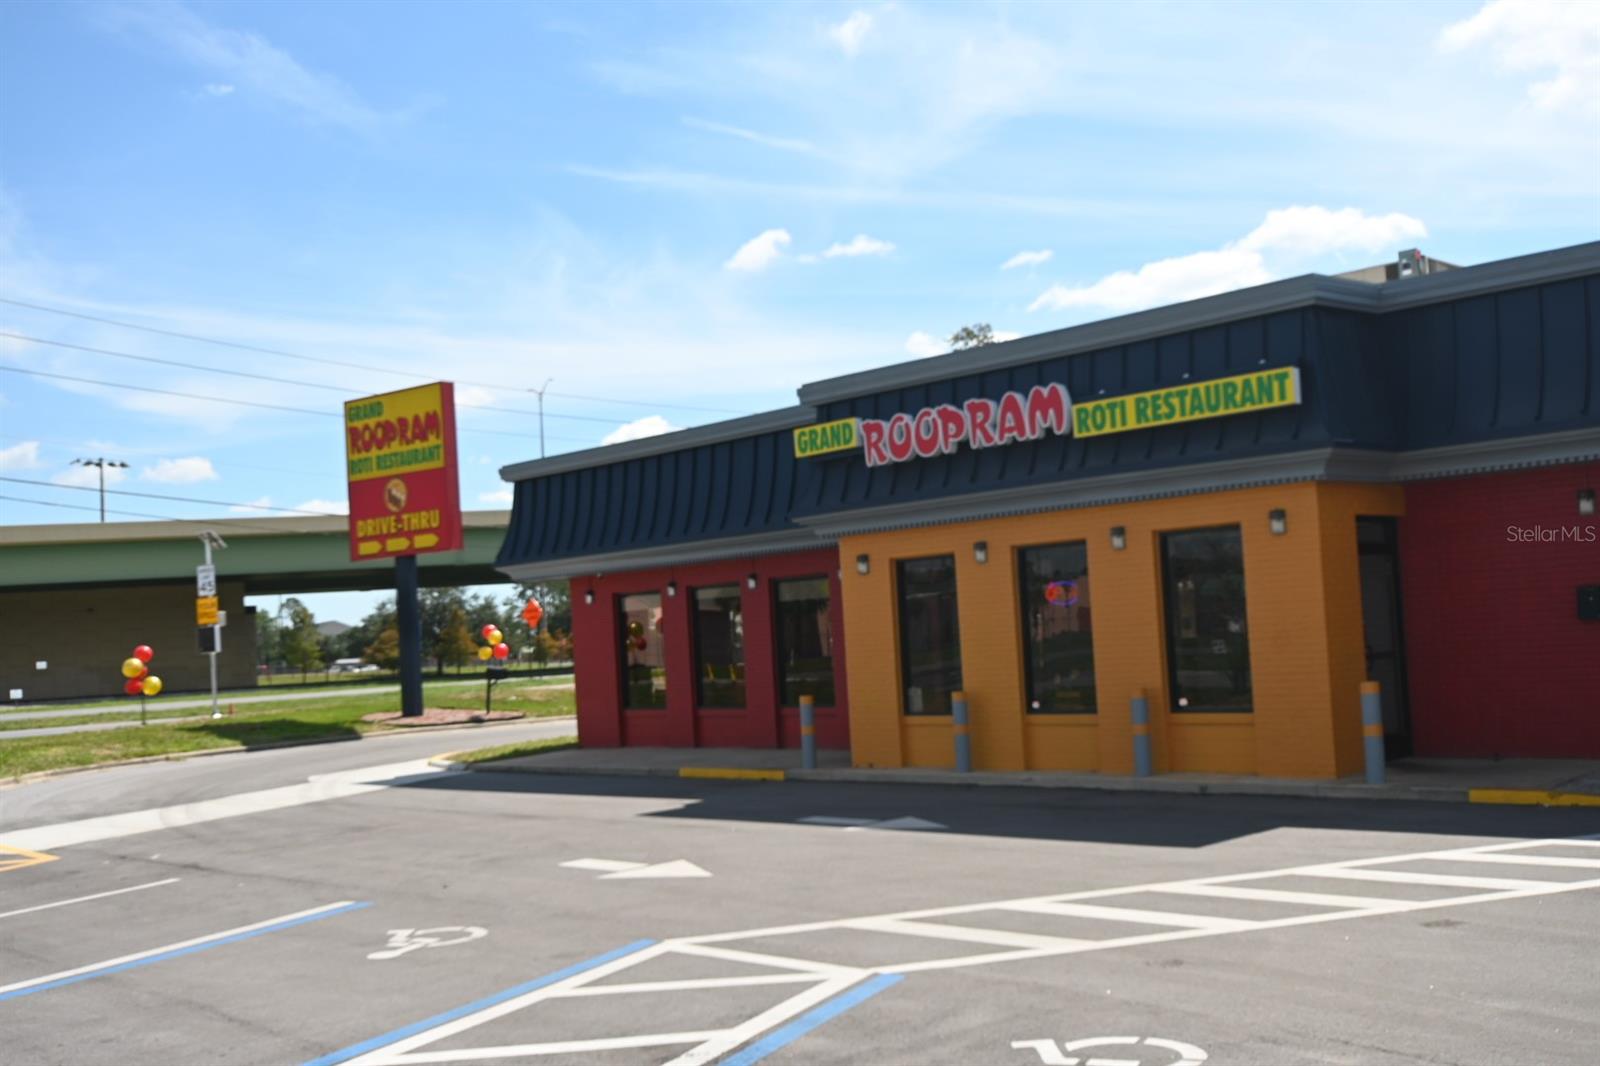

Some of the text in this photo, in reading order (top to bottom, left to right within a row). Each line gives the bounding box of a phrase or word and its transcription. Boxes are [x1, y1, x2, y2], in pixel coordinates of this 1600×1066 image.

[348, 402, 383, 421] GRAND
[799, 372, 1290, 467] GRAND ROOPRAM ROTI RESTAURANT
[348, 411, 440, 453] ROOPRAM
[376, 446, 441, 469] RESTAURANT
[356, 510, 440, 538] DRIVE-THRU
